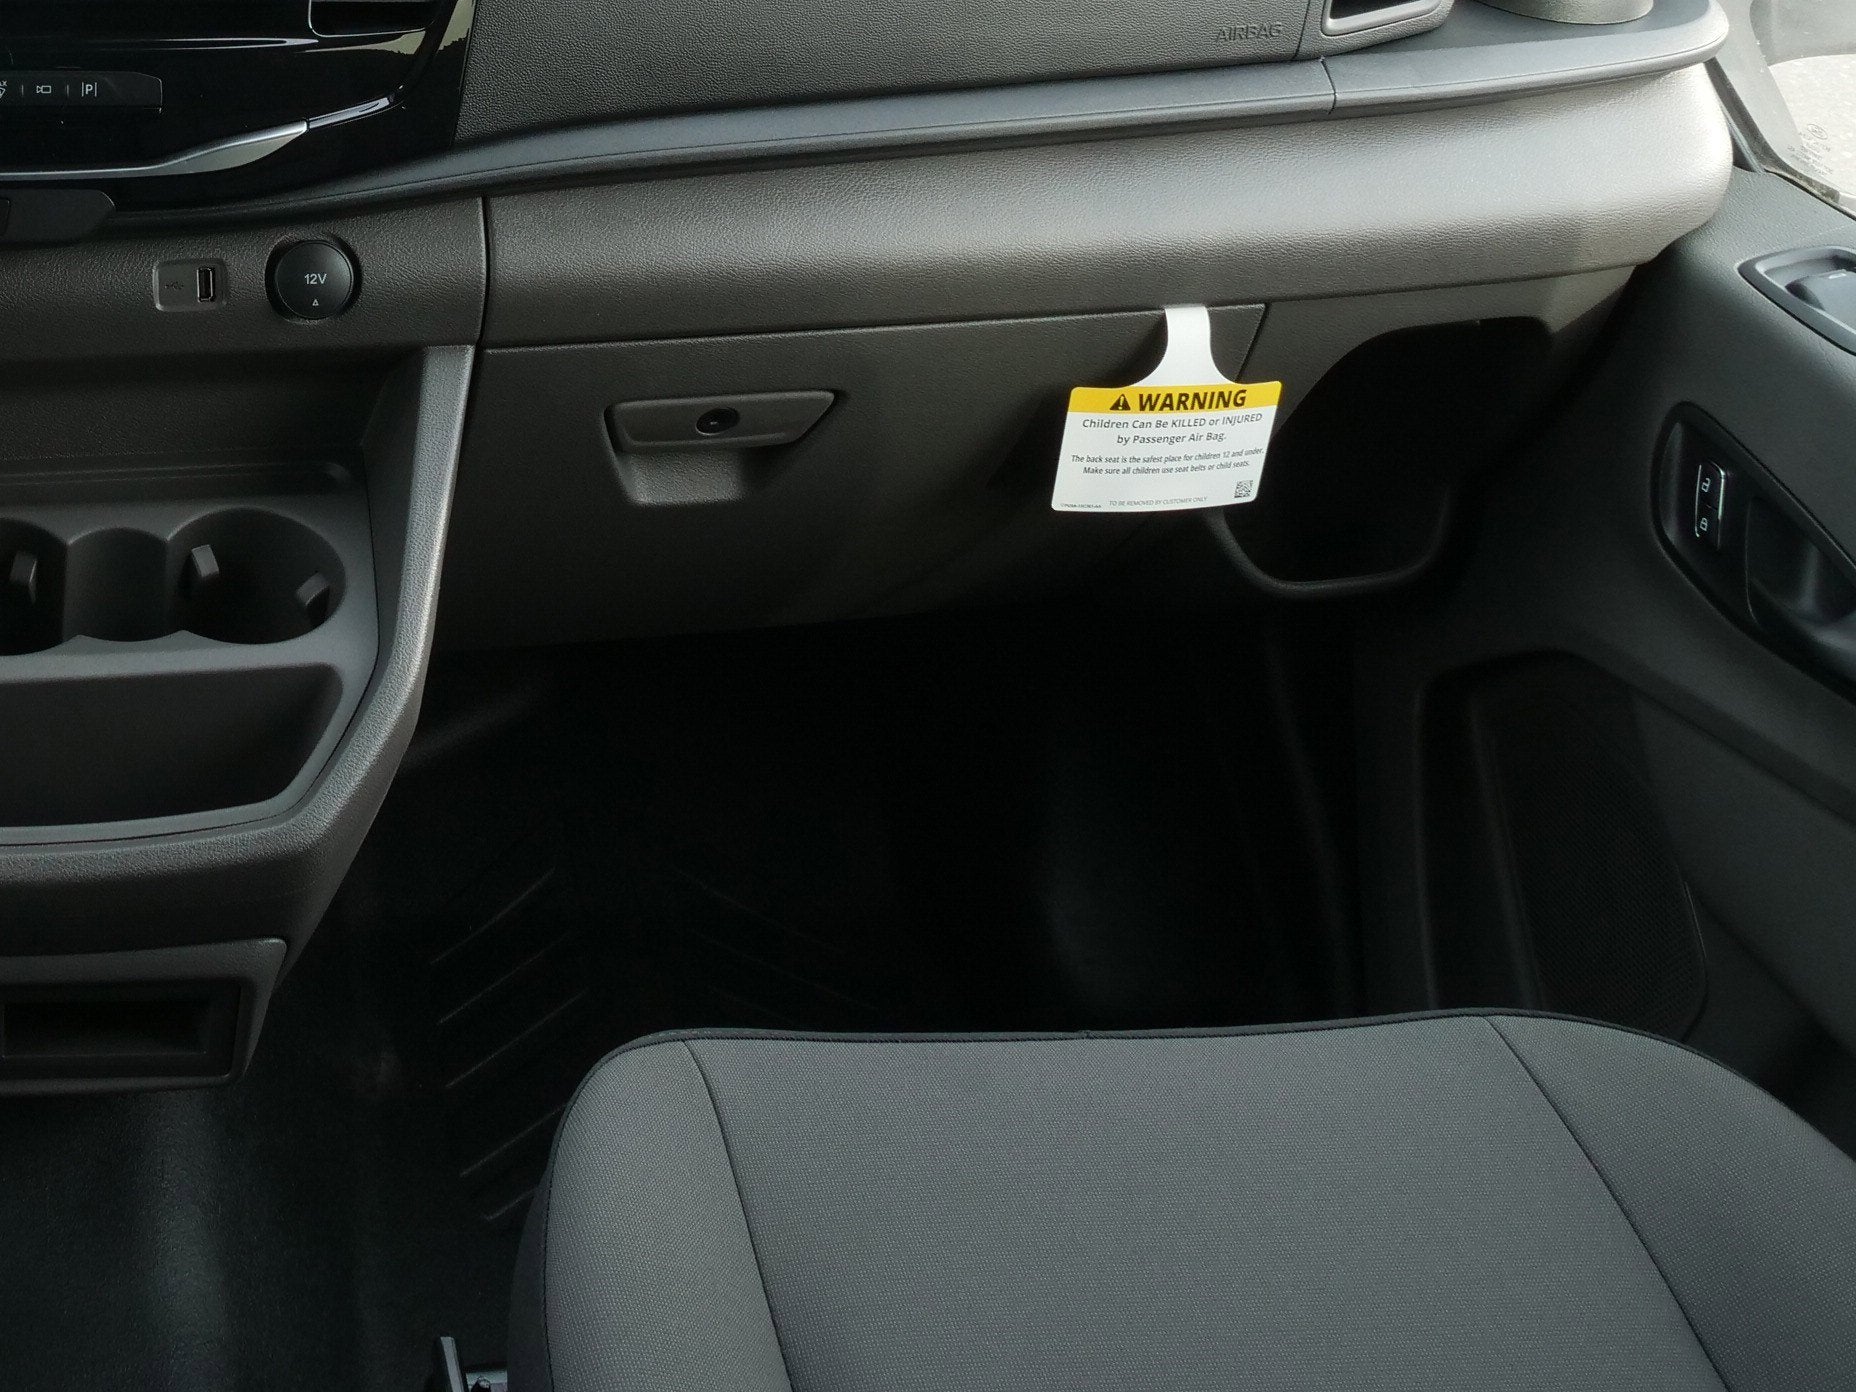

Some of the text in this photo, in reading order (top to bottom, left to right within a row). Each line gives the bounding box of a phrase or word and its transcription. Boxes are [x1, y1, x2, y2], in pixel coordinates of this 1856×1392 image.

[1215, 21, 1283, 44] AIRBAG
[304, 273, 328, 285] 12V
[1137, 389, 1247, 412] WARNING
[1082, 412, 1264, 429] Children Can Be KILLED or INJURED
[1117, 431, 1227, 445] by Passenger Air Bag.
[1071, 454, 1085, 463] The
[1085, 454, 1103, 464] back
[1104, 455, 1120, 464] seat
[1128, 455, 1142, 464] the
[1143, 454, 1163, 464] safest
[1164, 454, 1183, 465] place
[1183, 453, 1194, 462] for
[1194, 451, 1221, 461] children
[1222, 450, 1231, 459] 12
[1231, 449, 1244, 458] and
[1244, 447, 1265, 457] under.
[1082, 466, 1104, 475] Make
[1104, 467, 1121, 475] sure
[1121, 466, 1132, 475] all
[1132, 466, 1161, 475] children
[1161, 467, 1173, 475] use
[1174, 465, 1190, 474] seat
[1190, 463, 1207, 473] belts
[1215, 461, 1232, 471] child
[1126, 499, 1155, 507] REMOVED
[1163, 498, 1193, 506] CUSTOMER
[1192, 496, 1208, 505] ONLY
